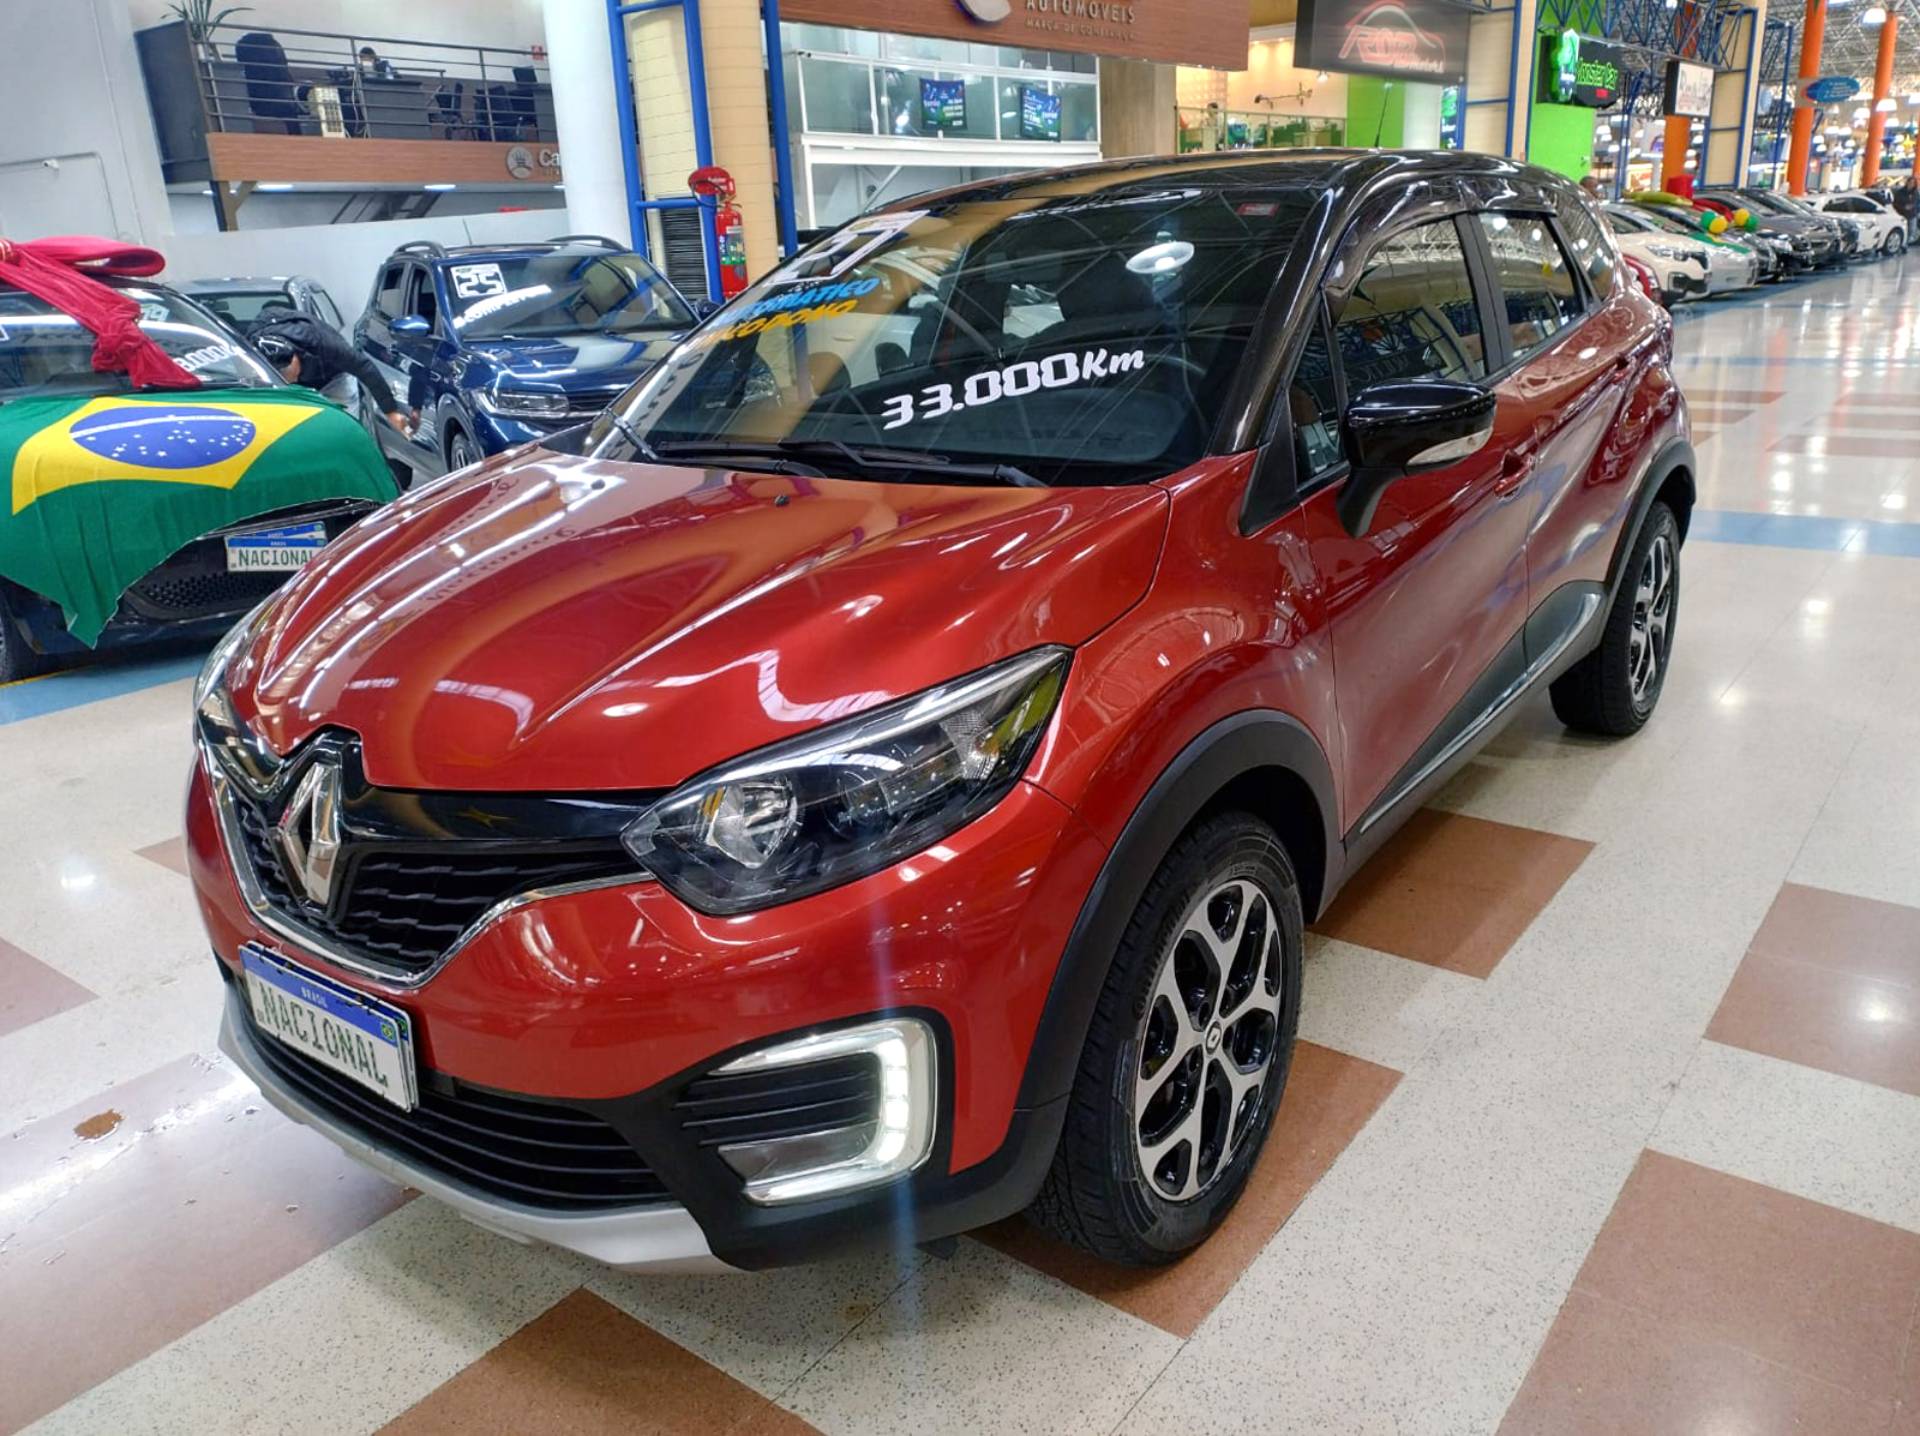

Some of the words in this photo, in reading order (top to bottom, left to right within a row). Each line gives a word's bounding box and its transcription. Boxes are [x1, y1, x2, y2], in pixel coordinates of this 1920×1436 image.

[456, 271, 502, 297] 25
[704, 278, 881, 331] OMATICO
[259, 981, 389, 1088] NACIONAL
